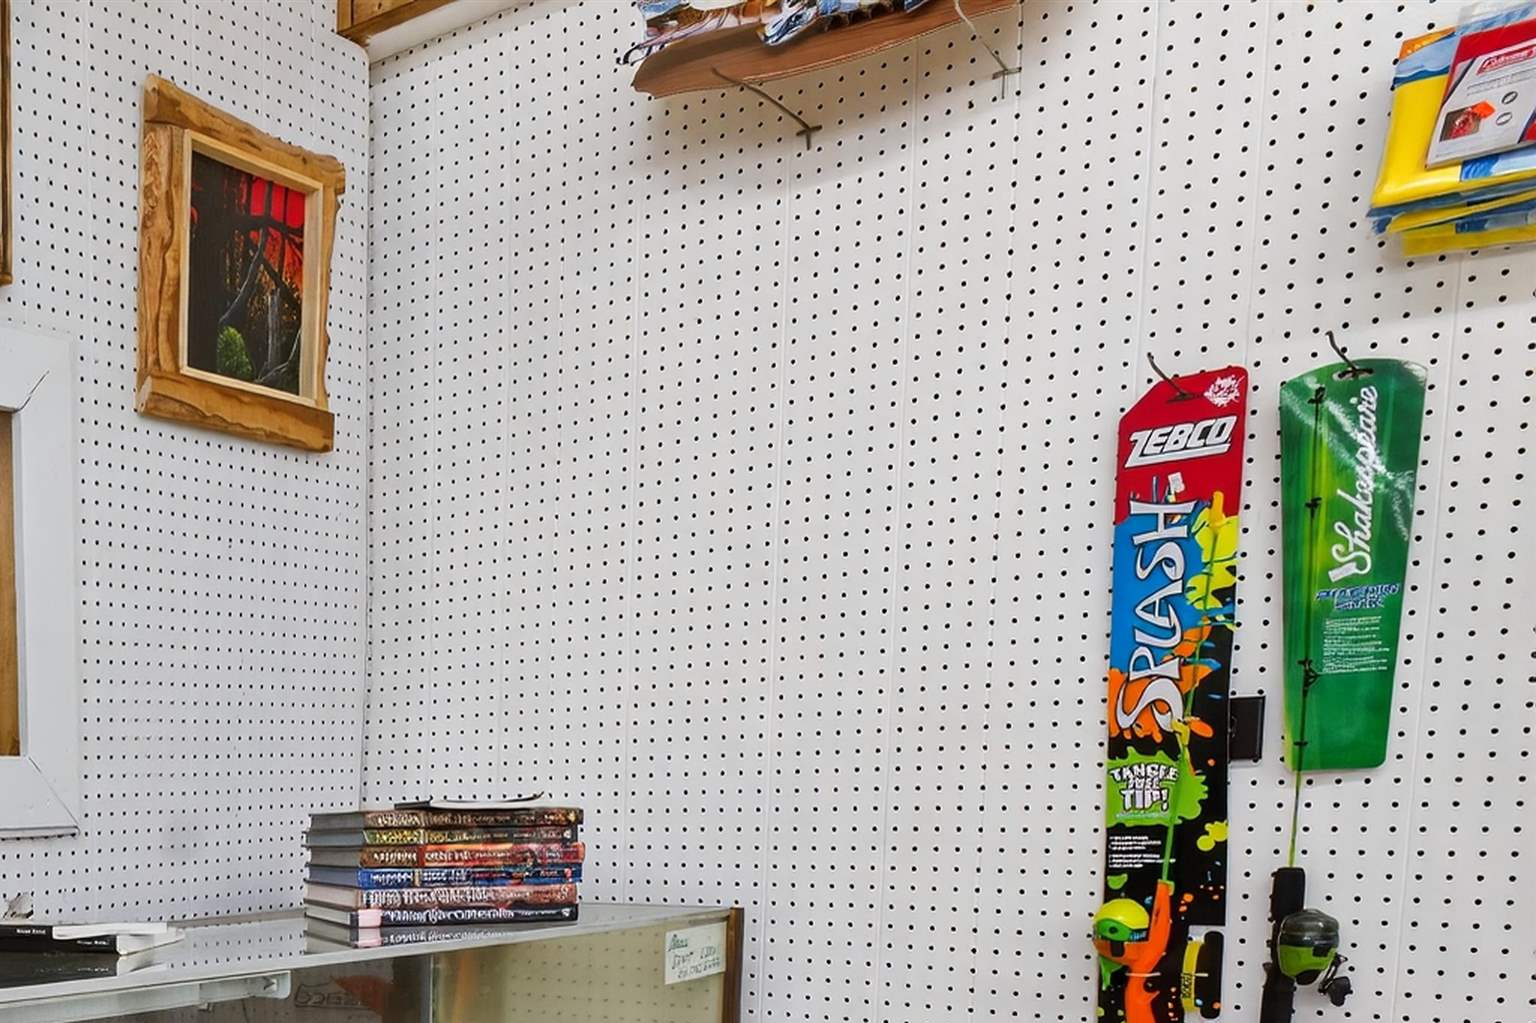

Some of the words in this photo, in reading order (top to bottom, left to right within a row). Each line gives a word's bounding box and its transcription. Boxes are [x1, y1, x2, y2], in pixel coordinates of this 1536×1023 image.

[1124, 416, 1237, 468] ZEBCO
[1328, 385, 1378, 582] Shakespeare
[1117, 498, 1197, 731] SPLASH
